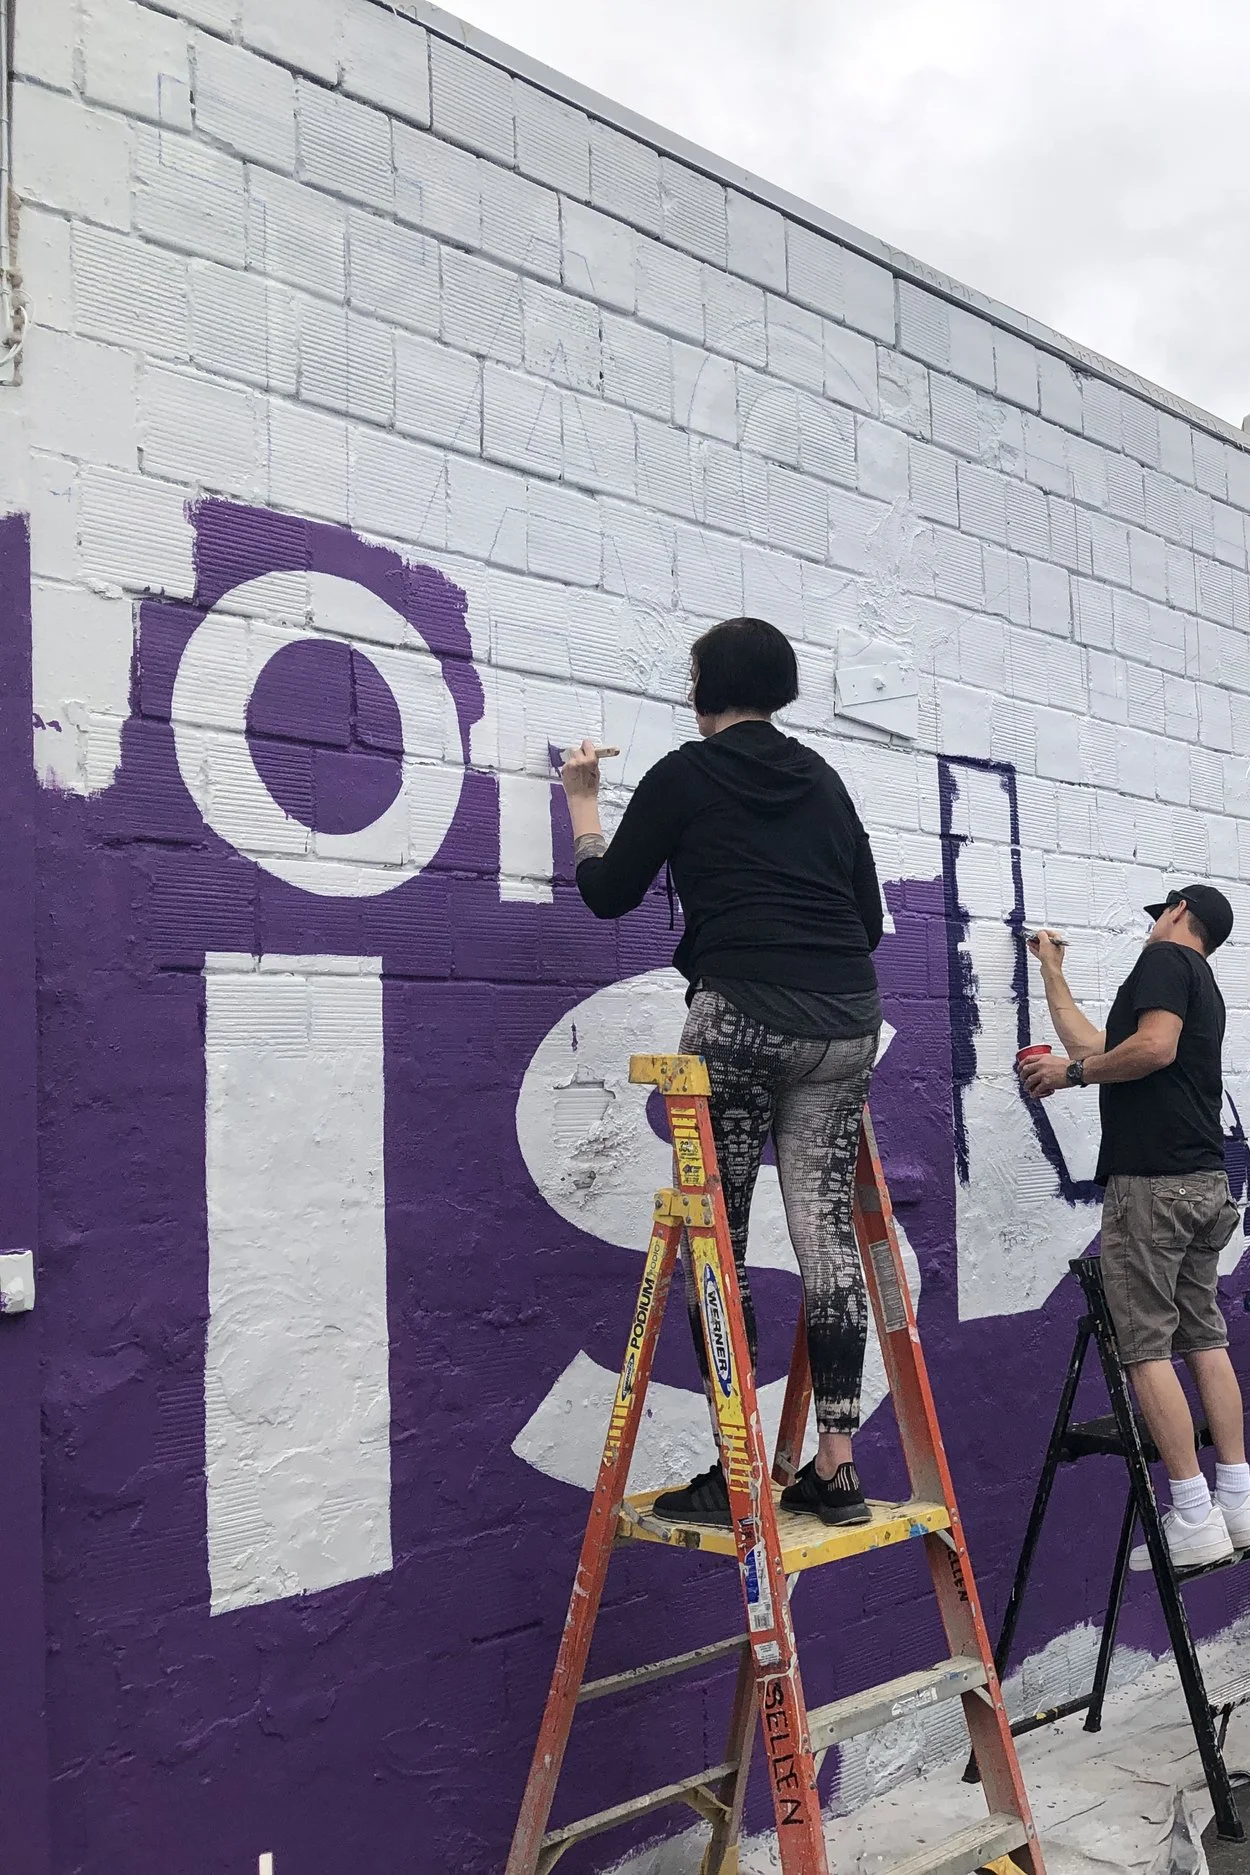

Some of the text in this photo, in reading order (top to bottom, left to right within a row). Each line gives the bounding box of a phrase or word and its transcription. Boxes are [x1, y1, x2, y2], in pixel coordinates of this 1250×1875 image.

[630, 1276, 656, 1350] PODIUM
[707, 1289, 729, 1372] WERNER
[948, 1546, 969, 1602] ELLEN
[765, 1681, 804, 1826] SELLEN
